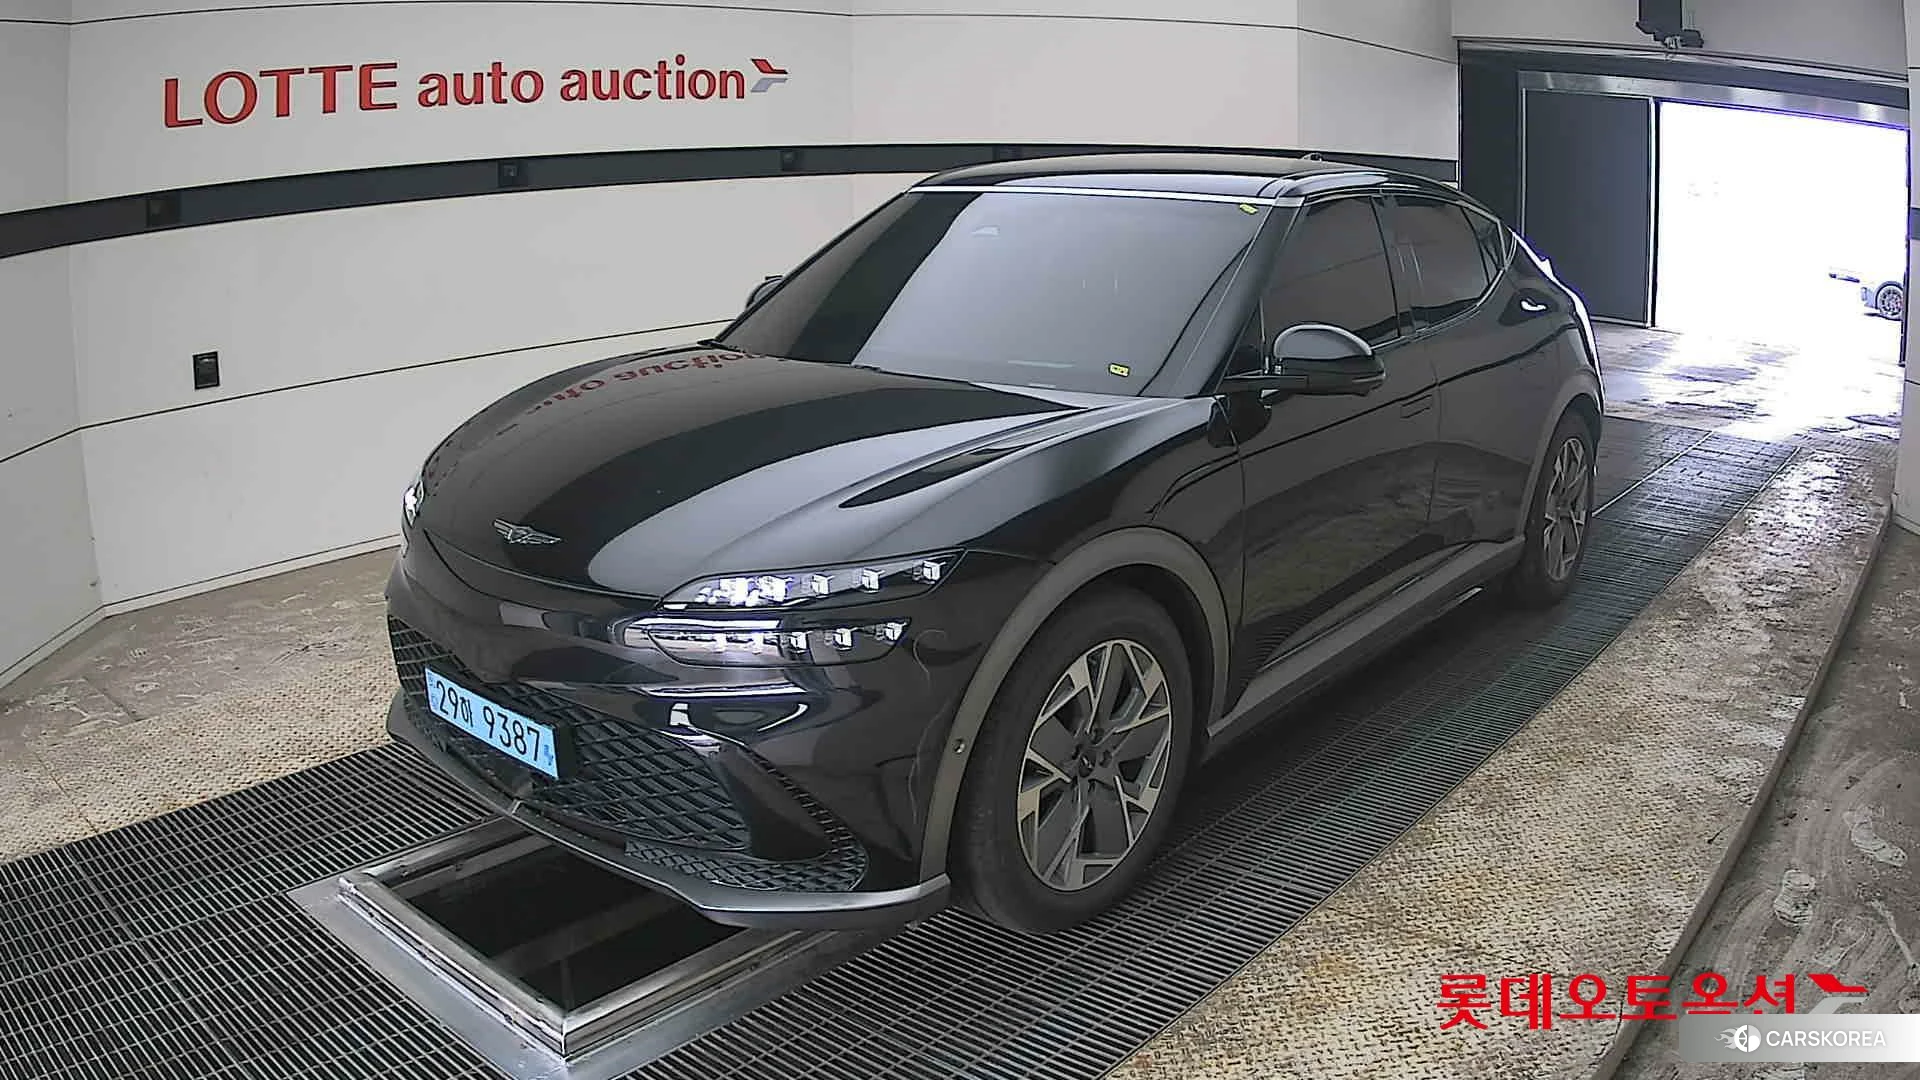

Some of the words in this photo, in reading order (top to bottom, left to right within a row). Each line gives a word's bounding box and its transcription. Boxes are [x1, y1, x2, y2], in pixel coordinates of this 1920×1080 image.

[164, 62, 398, 128] LOTTE
[417, 61, 544, 108] auto
[559, 54, 746, 102] auction
[482, 705, 541, 762] 9387
